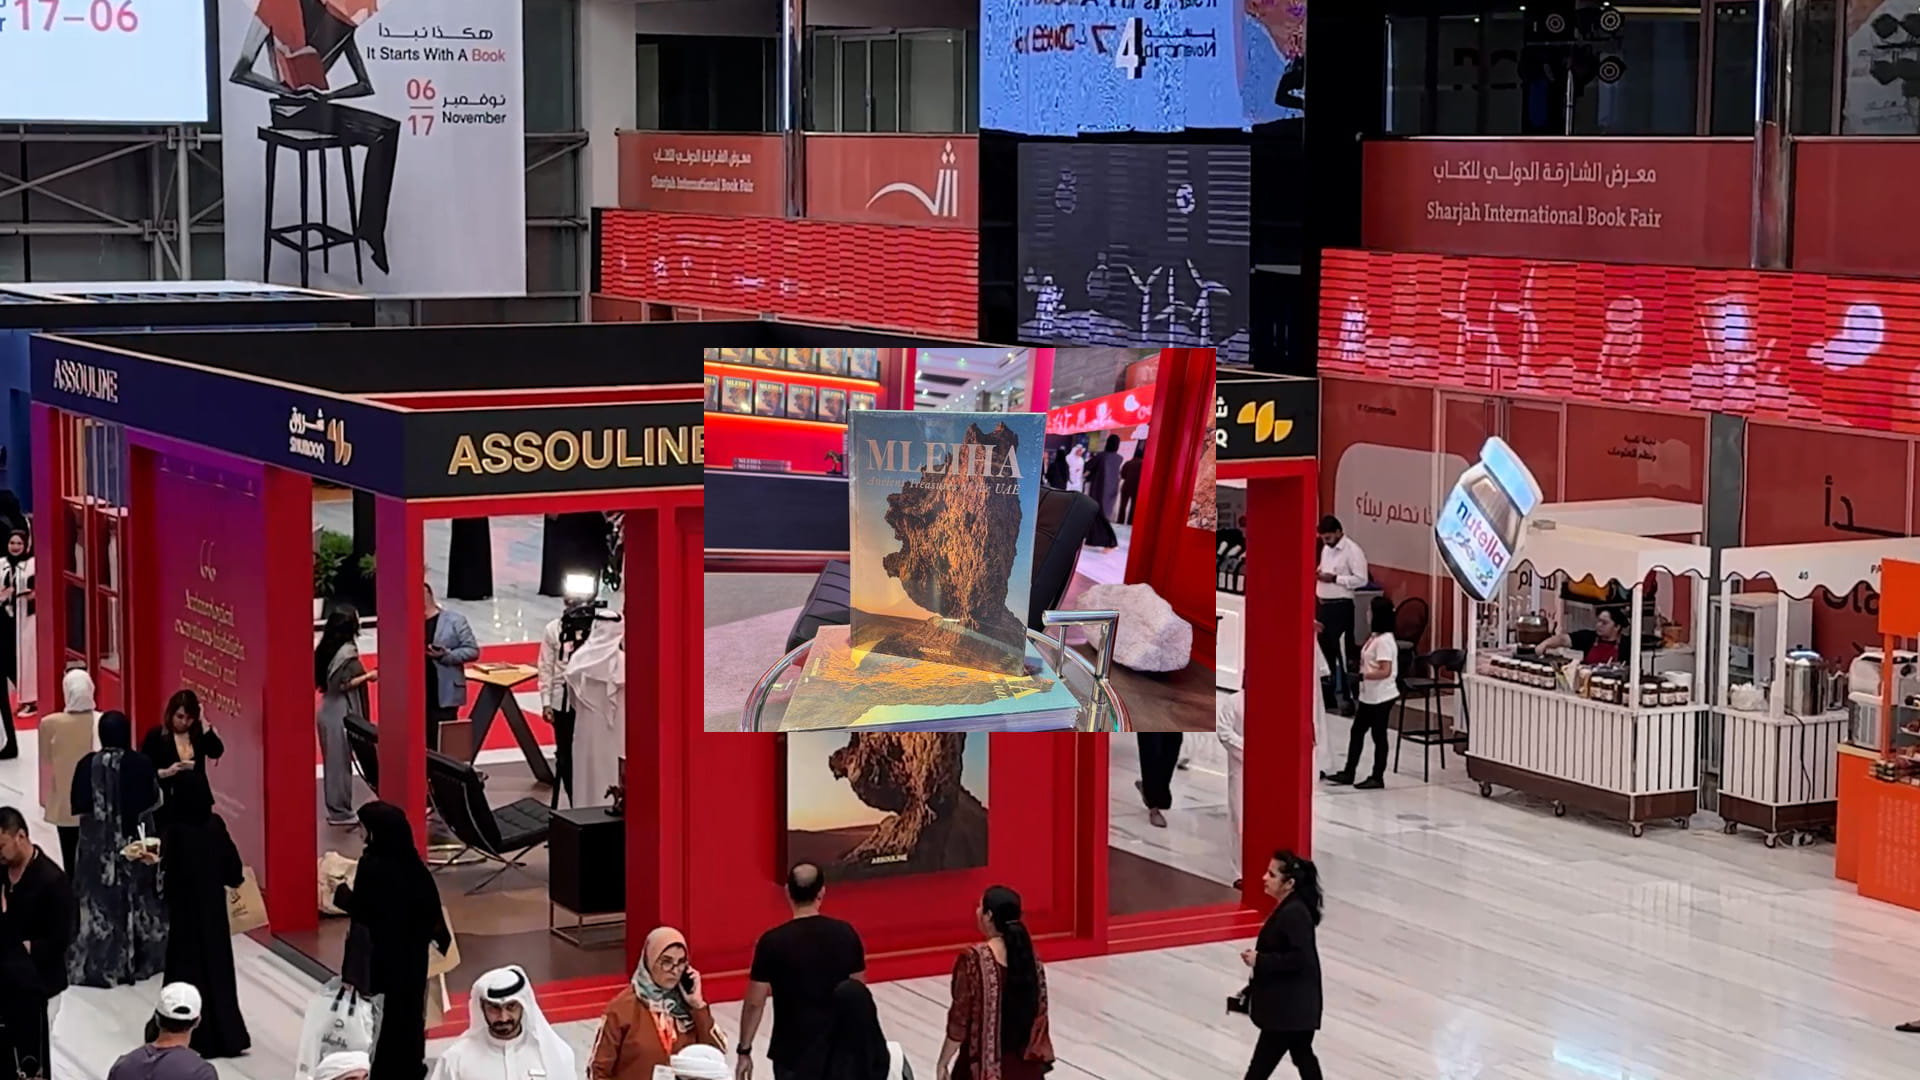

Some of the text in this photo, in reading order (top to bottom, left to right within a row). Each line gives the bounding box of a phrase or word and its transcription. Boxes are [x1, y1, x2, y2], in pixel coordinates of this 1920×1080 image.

[432, 25, 493, 40] هكذا
[367, 46, 506, 62] It Starts With A Book
[1115, 17, 1142, 79] 4
[407, 79, 436, 100] 06
[442, 94, 506, 108] نوفمبر
[408, 115, 435, 136] 17
[443, 111, 506, 124] November
[1433, 160, 1657, 188] معرض الشارقة الدولي للكتاب
[1427, 201, 1662, 228] Sharjah International Book Fair
[53, 358, 118, 404] ASSOULINE
[865, 439, 1024, 479] MLEIHA
[995, 483, 1021, 495] UAE
[1456, 500, 1505, 569] nutella
